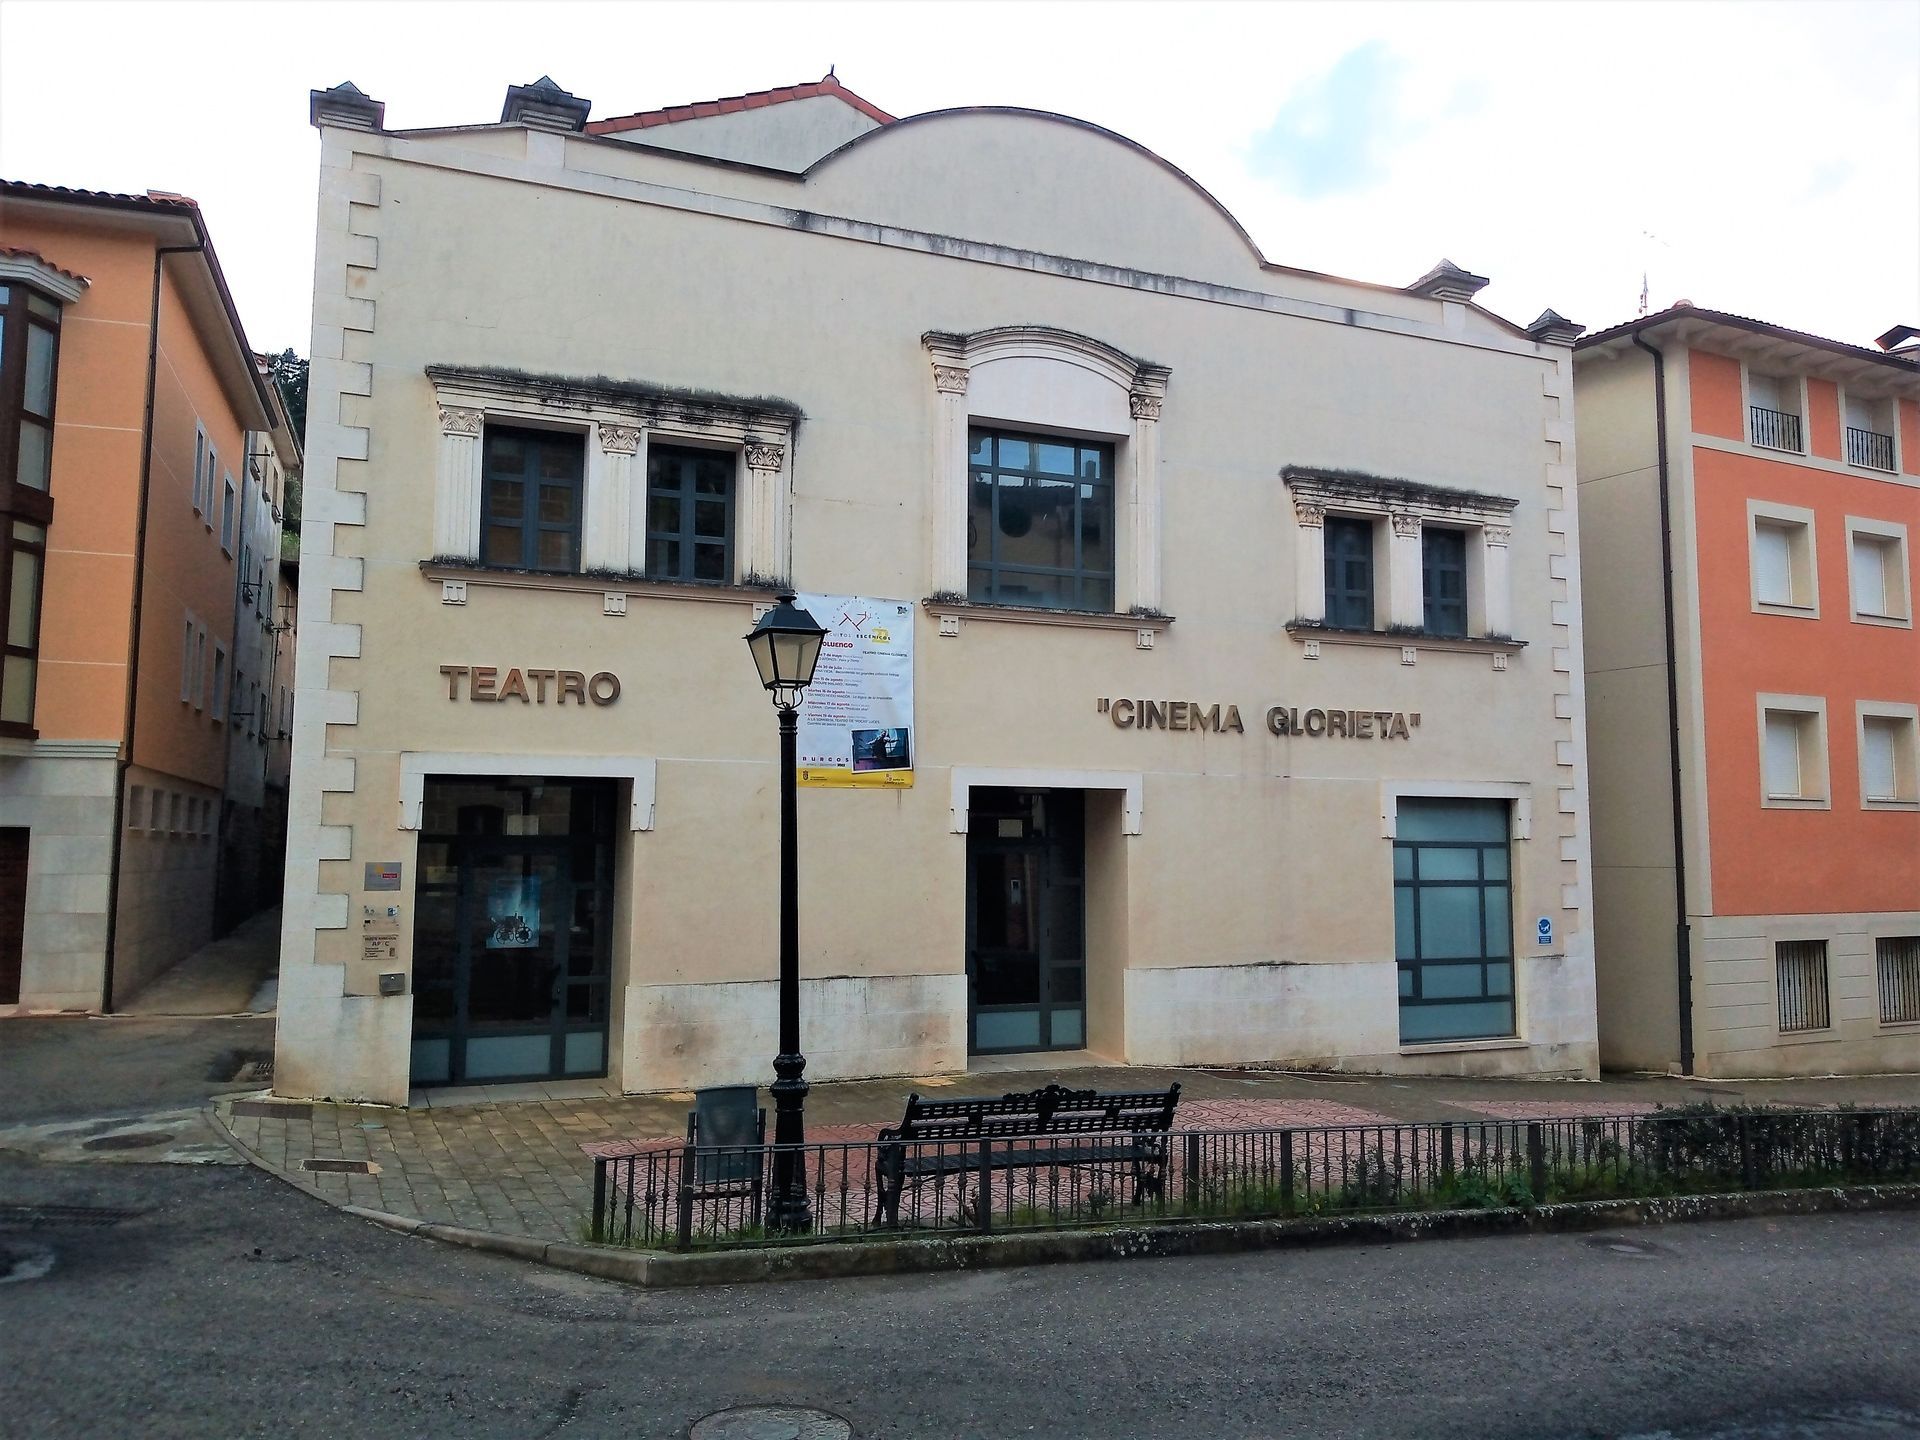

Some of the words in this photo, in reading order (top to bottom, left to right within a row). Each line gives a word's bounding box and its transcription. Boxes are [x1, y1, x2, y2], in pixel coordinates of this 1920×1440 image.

[439, 665, 621, 706] TEATRO
[1097, 697, 1244, 734] "CINEMA
[1266, 706, 1421, 740] GLORIETA"
